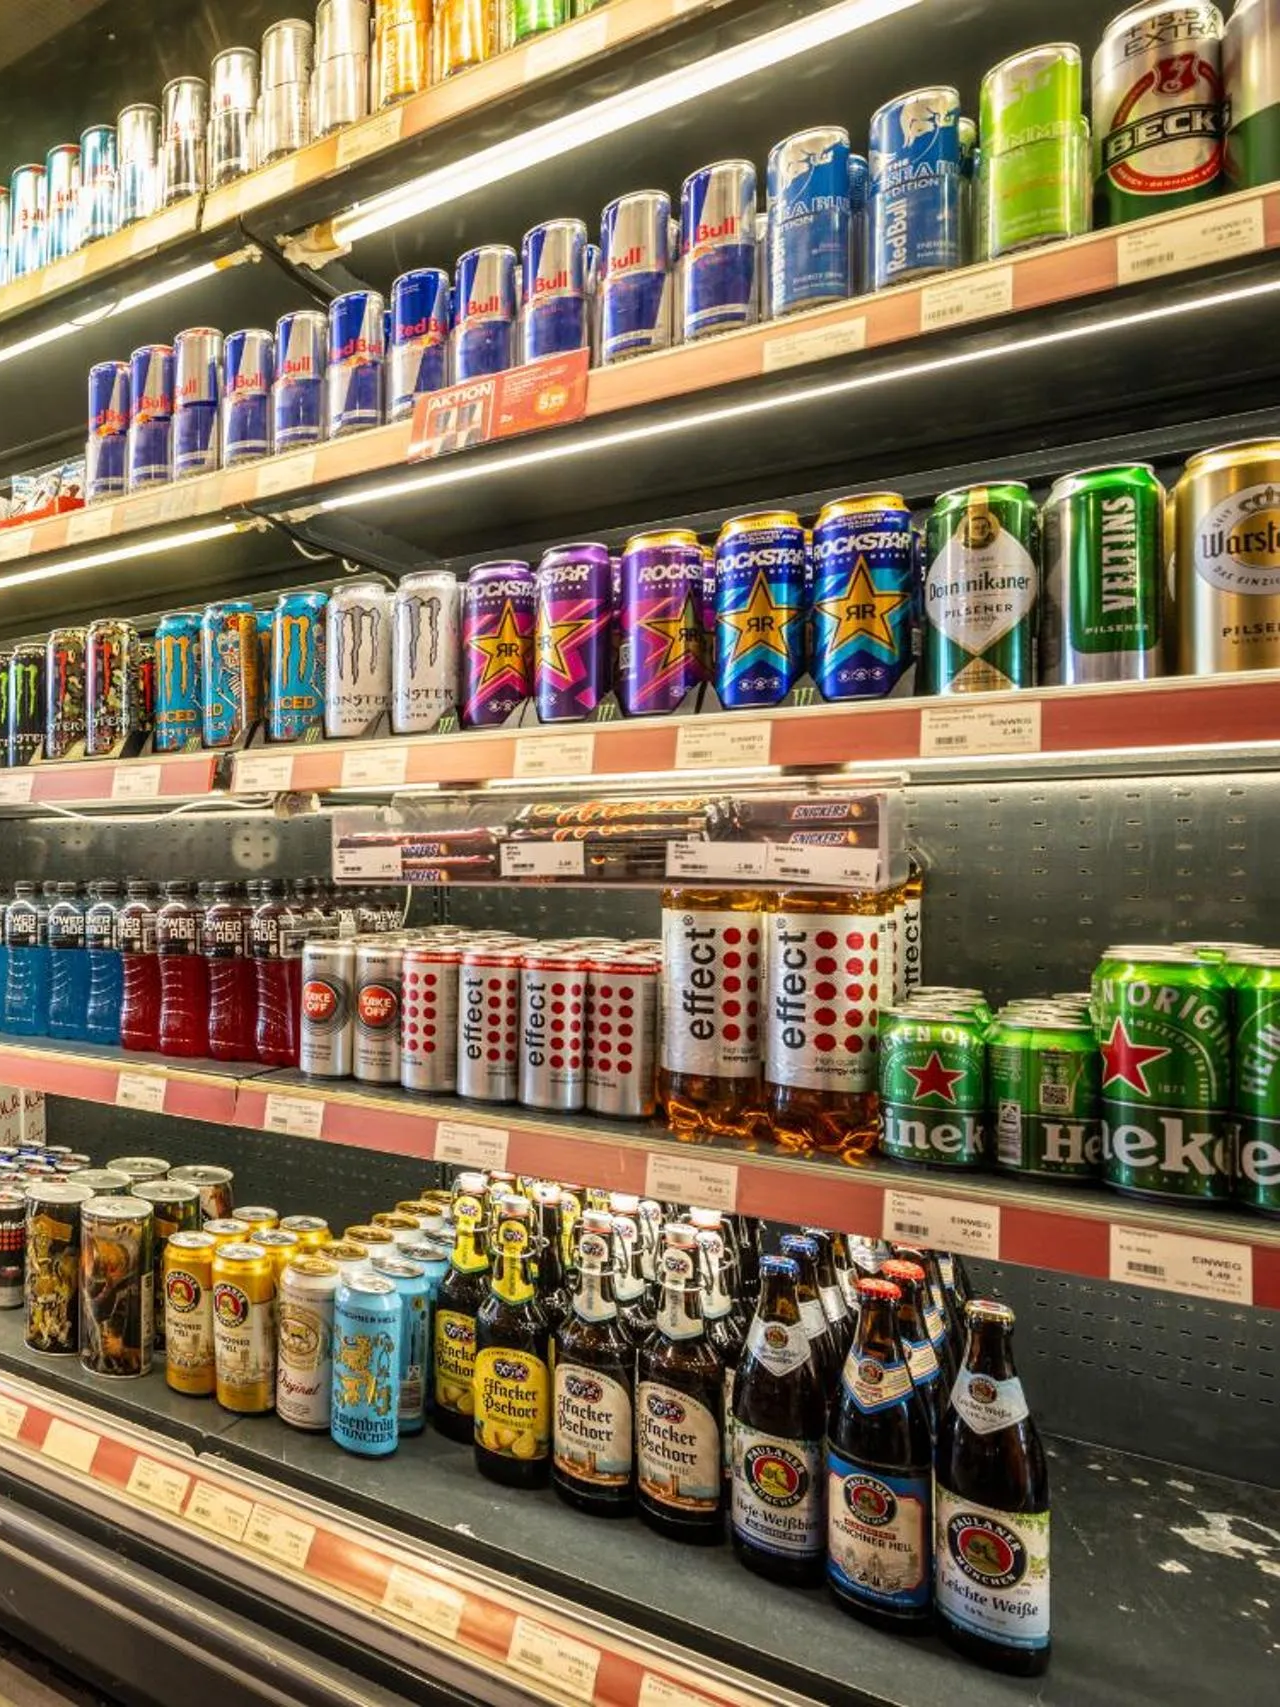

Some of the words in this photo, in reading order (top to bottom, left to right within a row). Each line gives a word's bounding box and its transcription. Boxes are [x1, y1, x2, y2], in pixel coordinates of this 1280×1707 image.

[1124, 22, 1218, 56] EXTRA
[887, 199, 908, 274] RedBull
[430, 382, 492, 409] AKTION
[814, 532, 912, 561] ROCKSTAR
[1202, 520, 1280, 559] Warst
[716, 549, 805, 575] ROCKSTAR
[1102, 496, 1139, 614] VELTINS
[944, 603, 1014, 618] PILSENER
[1085, 624, 1149, 635] PILSENER
[1223, 622, 1280, 637] PILSE
[794, 804, 849, 819] SNICKERS
[791, 832, 845, 845] SNICKERS
[683, 927, 716, 1040] effect
[776, 930, 808, 1049] effect
[464, 977, 483, 1060] effect
[525, 982, 546, 1067] effect
[1192, 1255, 1242, 1270] EINWEG
[747, 1446, 806, 1475] PAULANER
[846, 1479, 894, 1502] PAULANER
[888, 1542, 914, 1553] HELL
[950, 1516, 1022, 1553] PAULANER
[941, 1570, 989, 1606] Leichte
[991, 1596, 1039, 1619] Weiße
